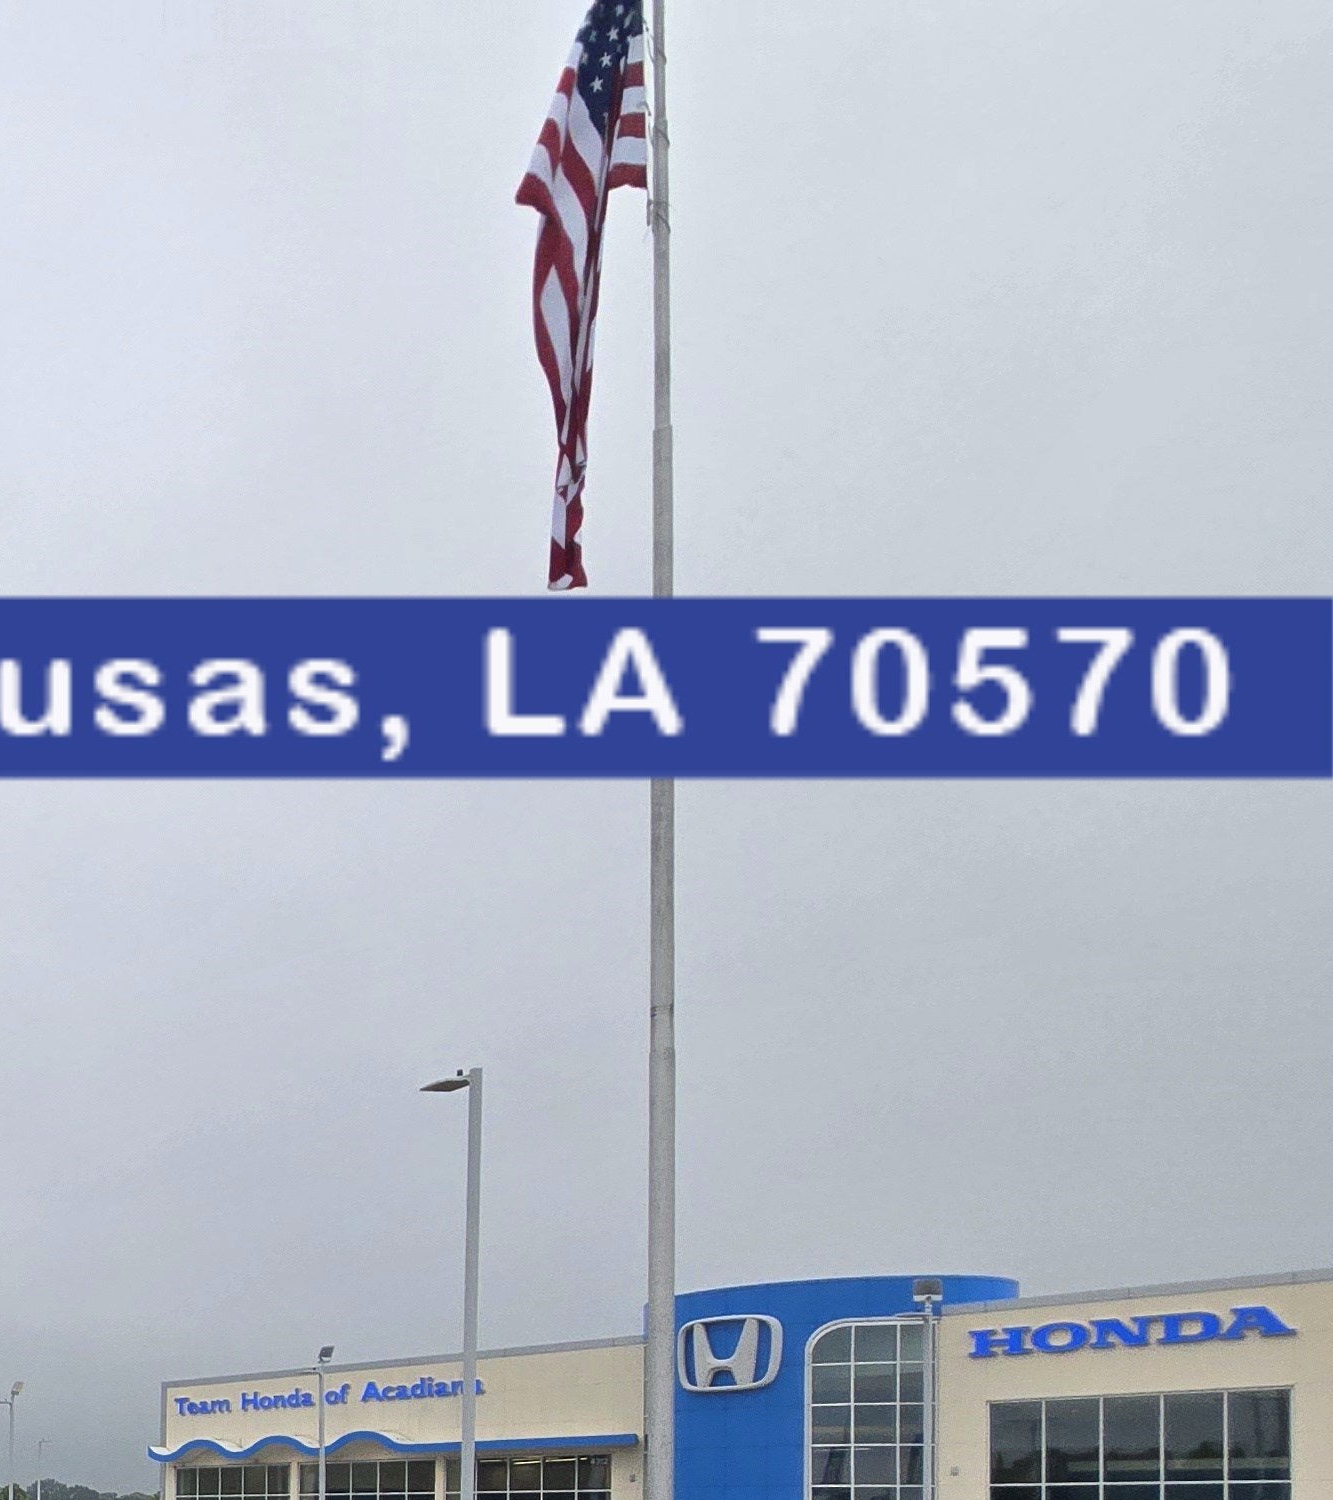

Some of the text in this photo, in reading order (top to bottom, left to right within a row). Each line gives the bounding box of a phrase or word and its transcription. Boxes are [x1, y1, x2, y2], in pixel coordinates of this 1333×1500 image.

[967, 1305, 1298, 1358] HONDA
[174, 1396, 232, 1417] Team
[241, 1390, 315, 1411] Honda
[324, 1383, 351, 1405] of
